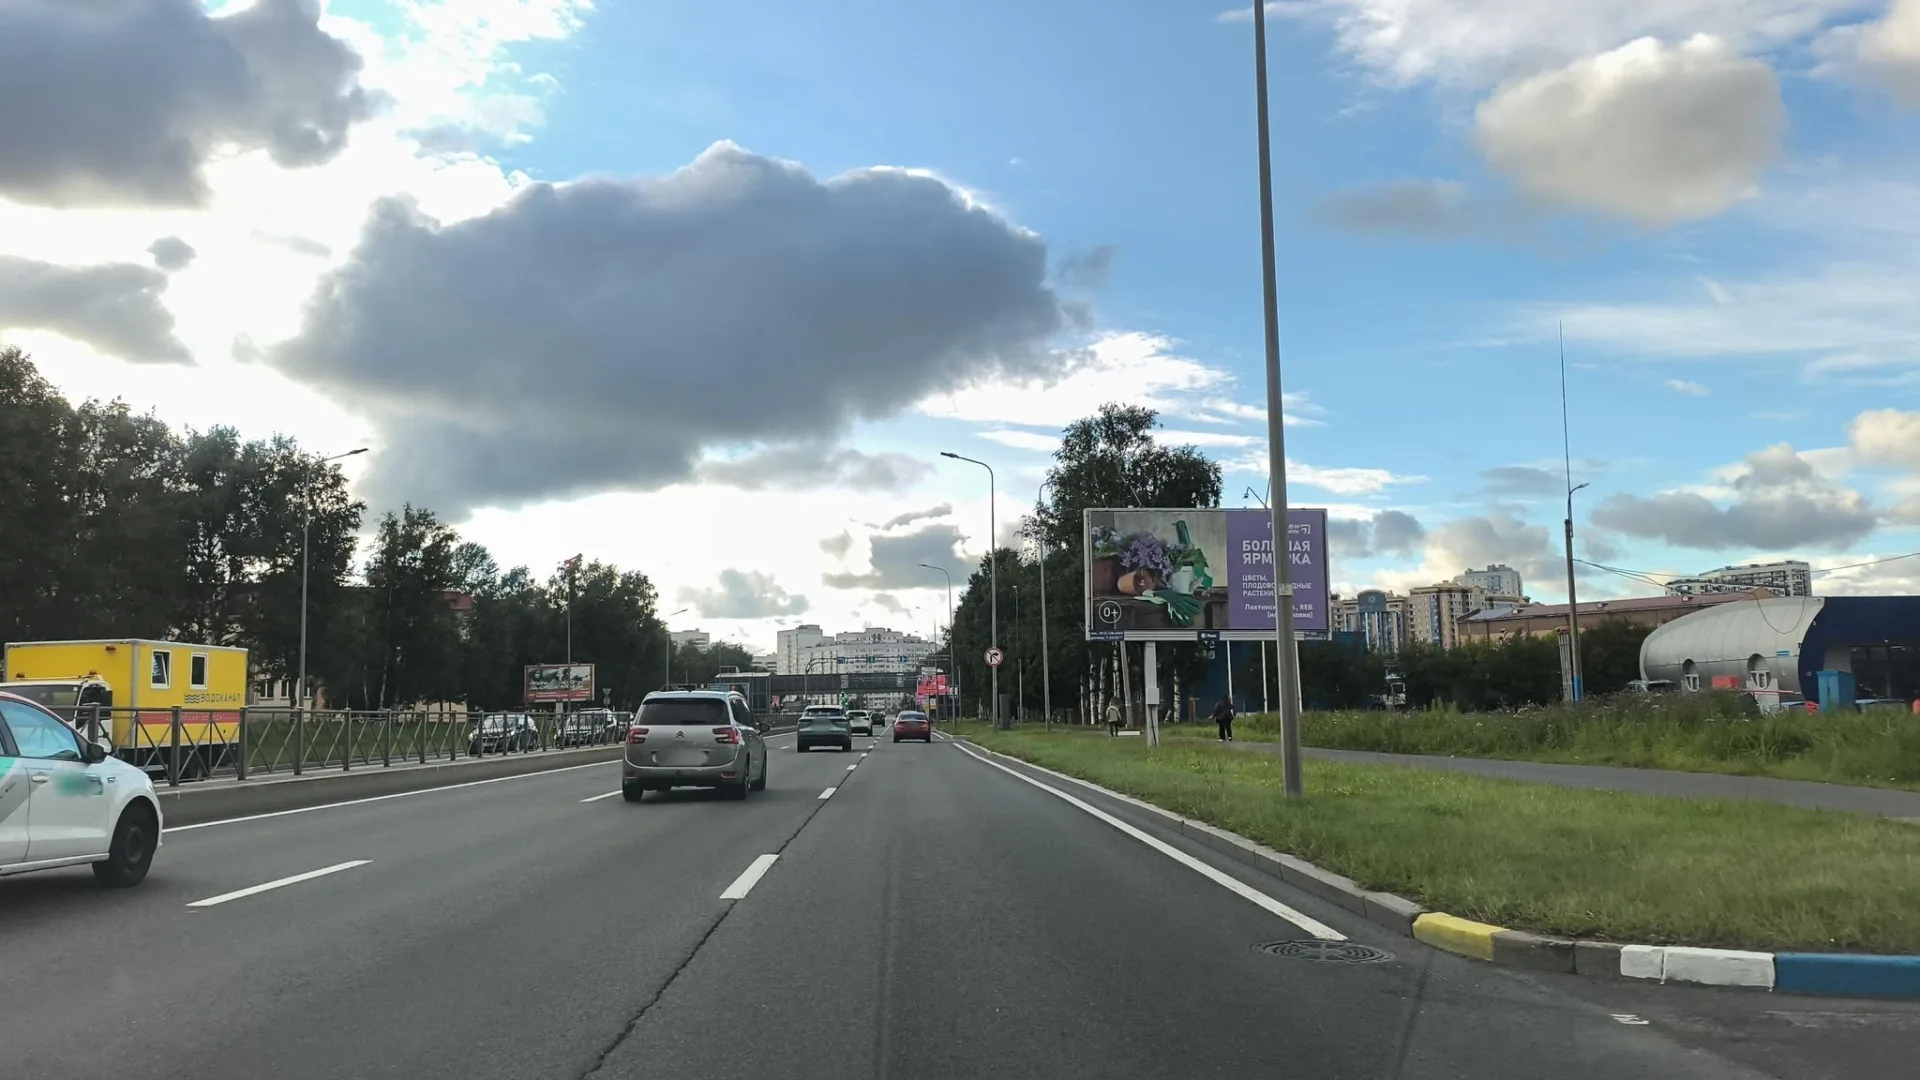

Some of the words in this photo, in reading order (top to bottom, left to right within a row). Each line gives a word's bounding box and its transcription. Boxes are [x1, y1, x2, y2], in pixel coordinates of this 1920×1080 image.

[1242, 540, 1311, 552] БОЛАЯ
[1242, 553, 1312, 565] ЯРМКА
[1242, 574, 1268, 582] ЦВЕТЫ,
[1242, 582, 1312, 590] ПЛОДОВОДНЫЕ
[1103, 607, 1119, 617] 0+
[200, 692, 241, 703] ВОДОКАНАЛ
